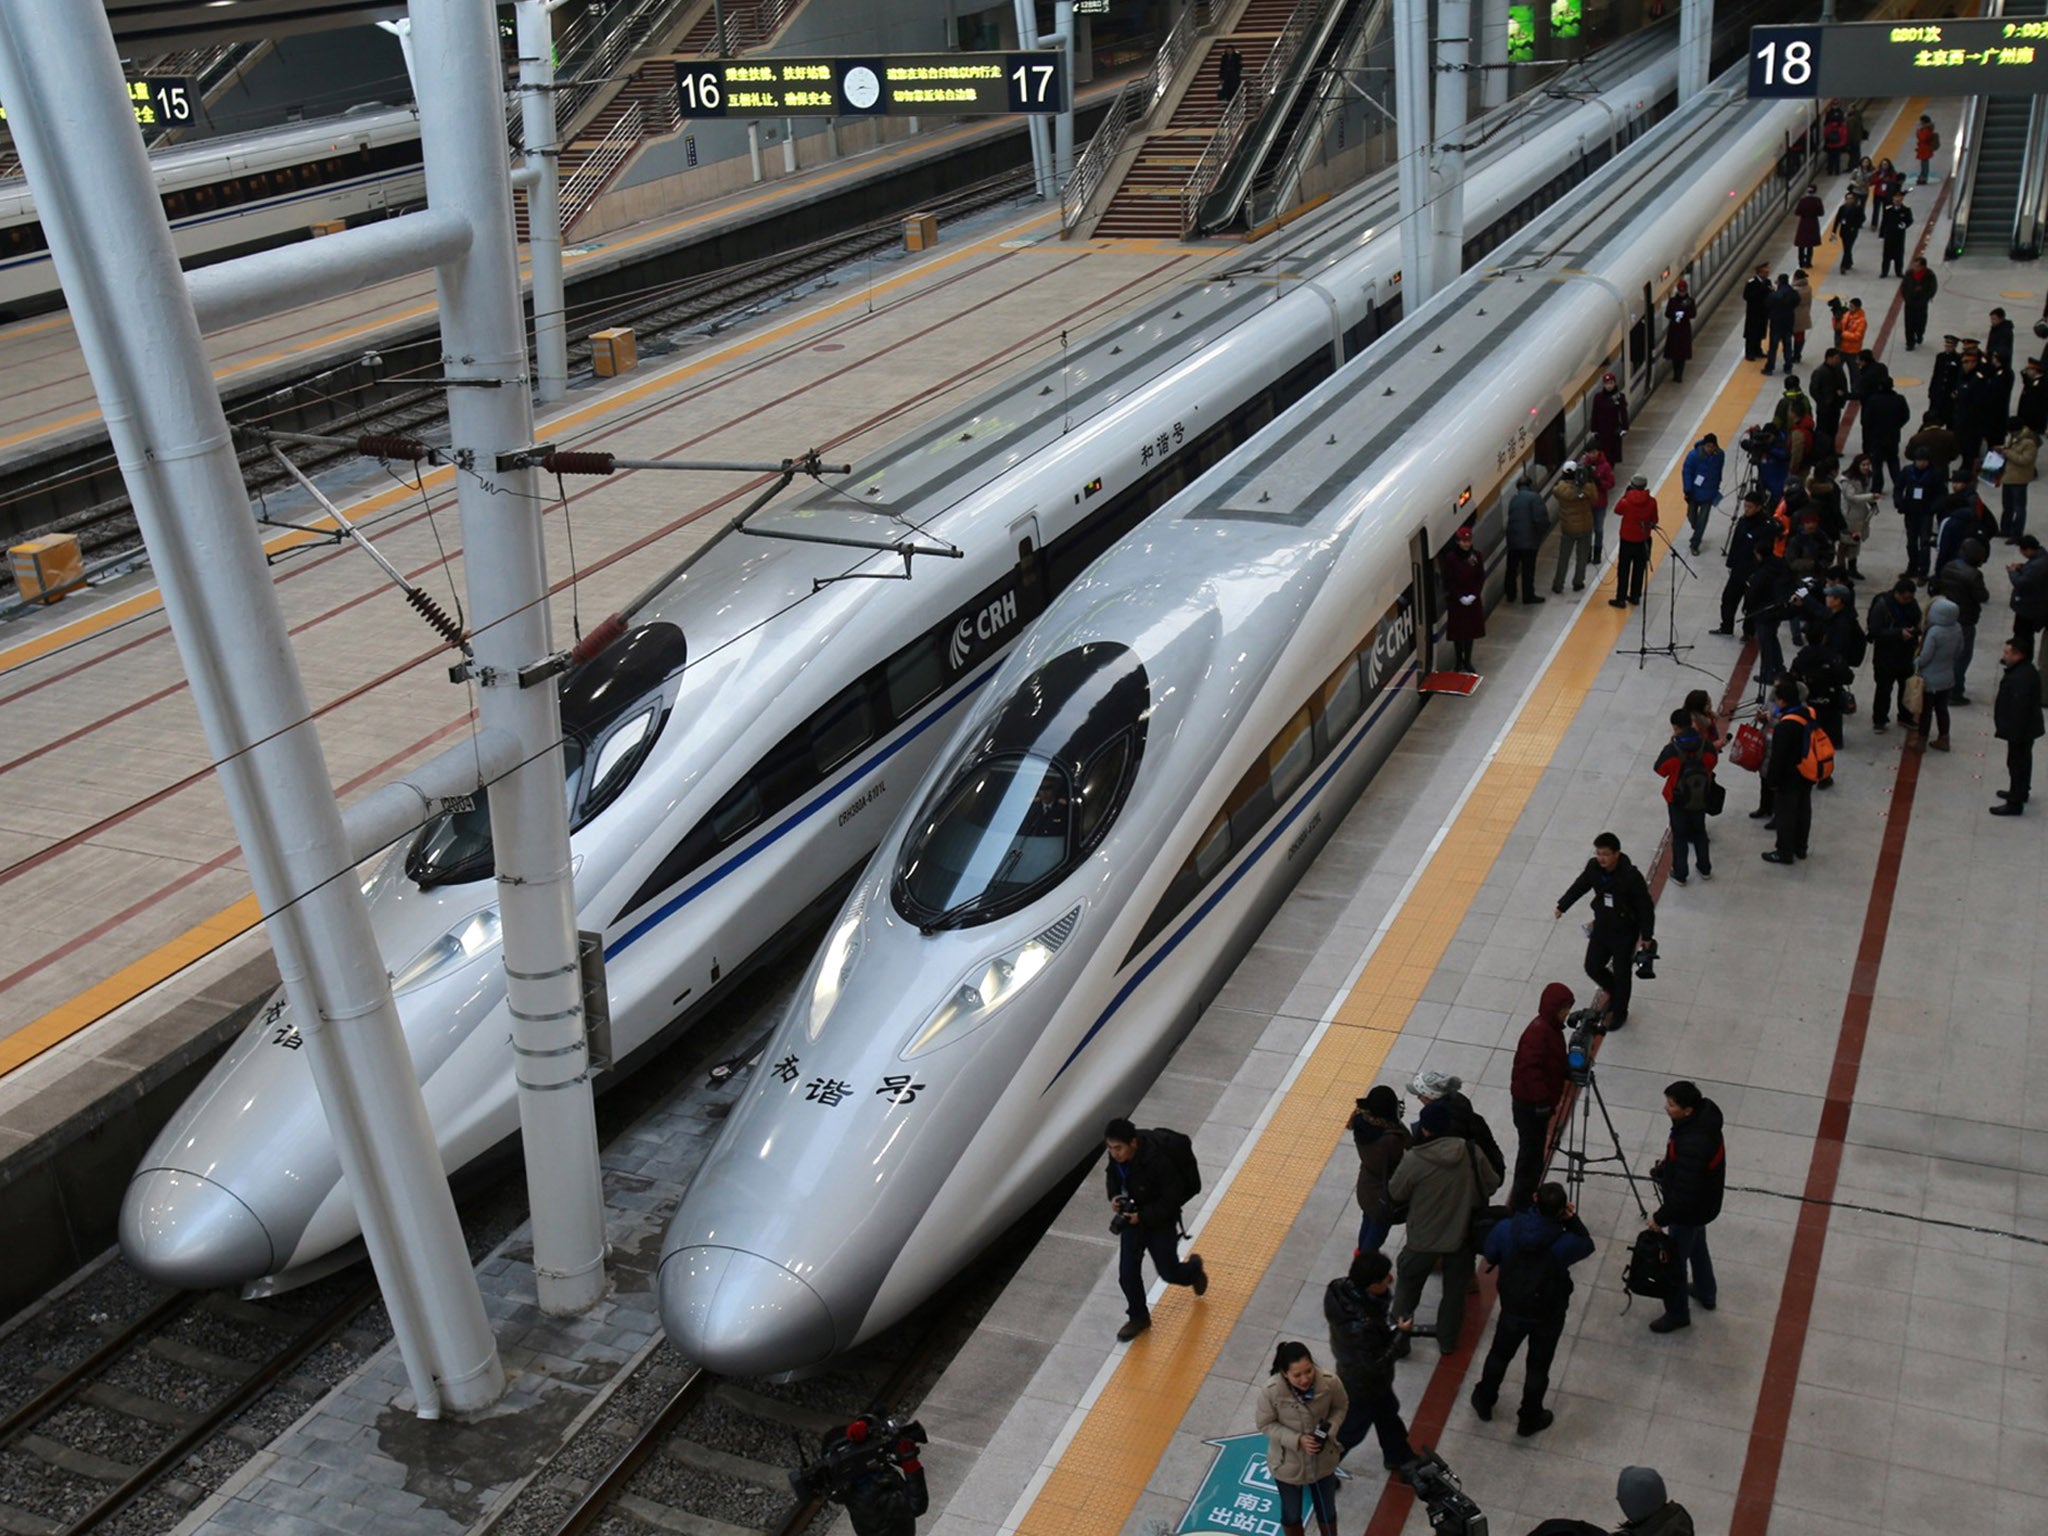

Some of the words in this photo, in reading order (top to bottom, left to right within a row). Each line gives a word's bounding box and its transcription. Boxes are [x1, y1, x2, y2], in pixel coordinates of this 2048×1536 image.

[1012, 65, 1054, 102] 17
[1757, 41, 1812, 85] 18
[157, 88, 189, 119] 15
[682, 73, 720, 109] 16
[1141, 421, 1185, 467] 和谐号
[1497, 426, 1527, 473] 和谐号
[976, 589, 1018, 640] CRH
[1386, 604, 1414, 658] CRH
[770, 1054, 926, 1107] 和谐号
[1208, 1507, 1281, 1536] 出站口
[1234, 1492, 1273, 1513] 南3
